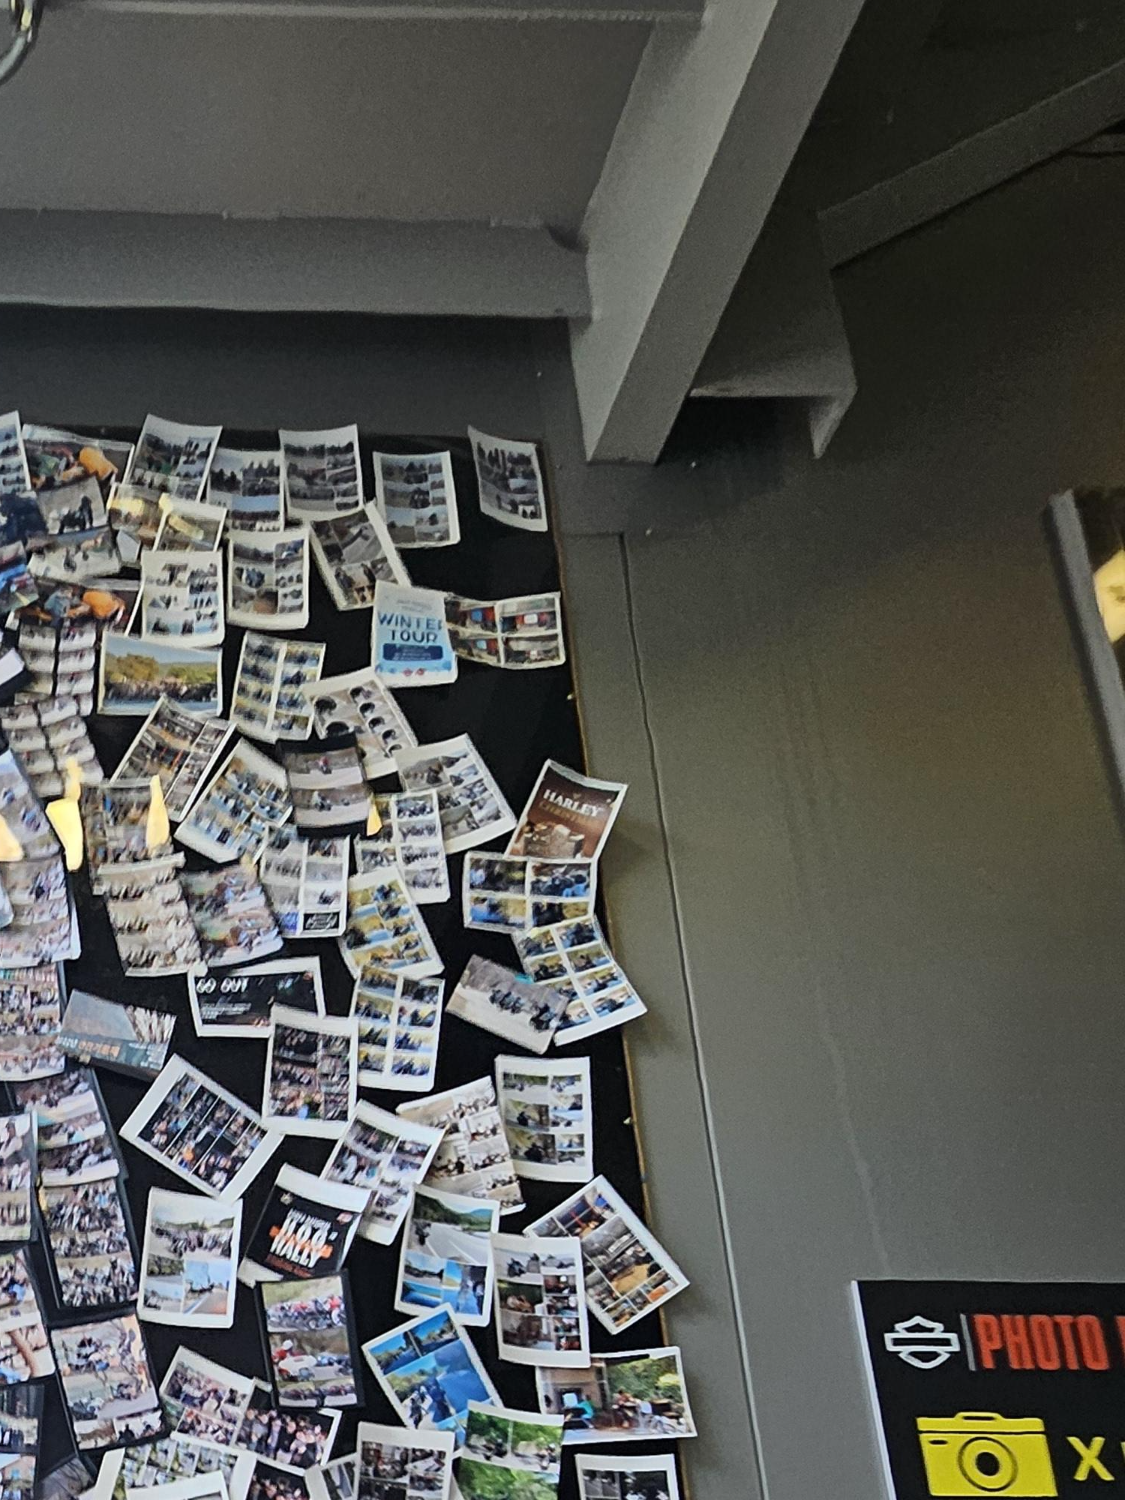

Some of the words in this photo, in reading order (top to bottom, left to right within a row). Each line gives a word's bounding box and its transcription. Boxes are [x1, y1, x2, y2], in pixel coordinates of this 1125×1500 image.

[390, 629, 438, 644] TOUR
[543, 789, 599, 817] HARLEY
[972, 1313, 1110, 1370] PHOTO
